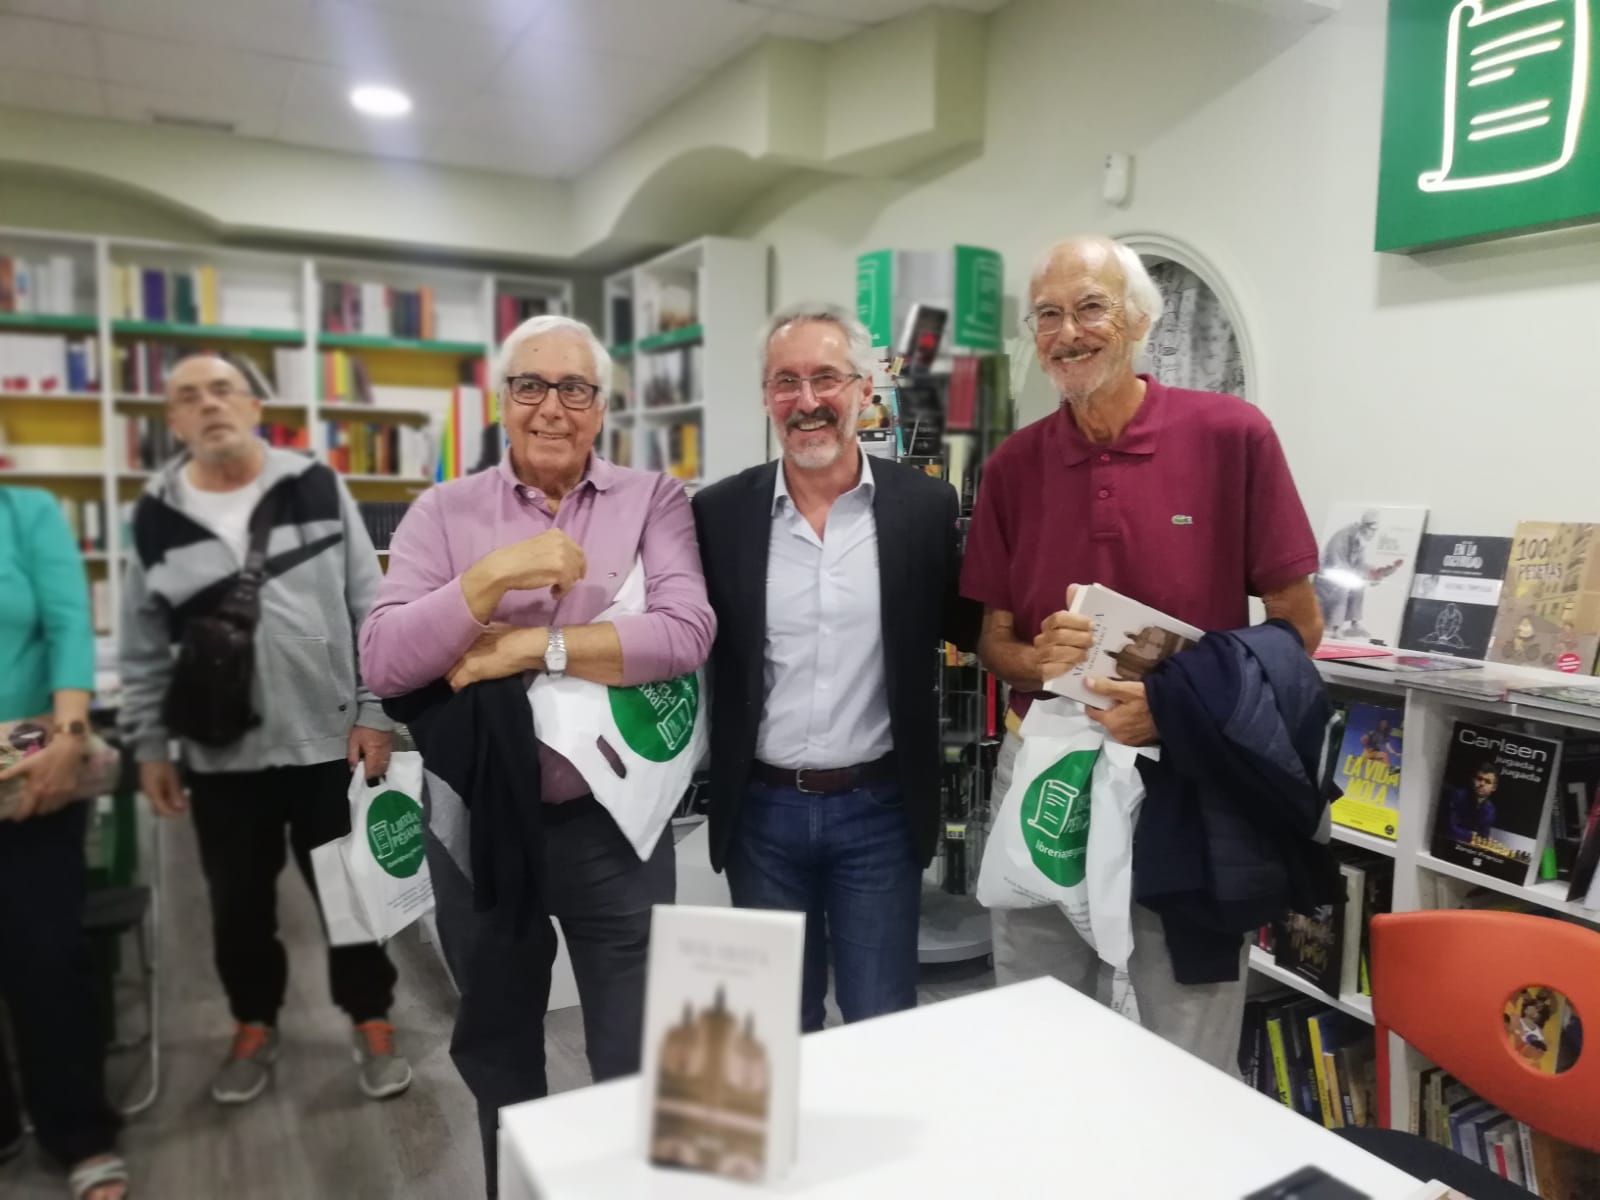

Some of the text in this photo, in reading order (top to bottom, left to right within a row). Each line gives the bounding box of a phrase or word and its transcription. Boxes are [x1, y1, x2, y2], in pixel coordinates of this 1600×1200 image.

[1516, 538, 1548, 562] 100
[1459, 728, 1547, 762] Carlsen
[1344, 755, 1366, 778] LA
[1495, 755, 1536, 773] jugada
[1500, 766, 1541, 783] jugada
[1346, 778, 1388, 806] MOLA
